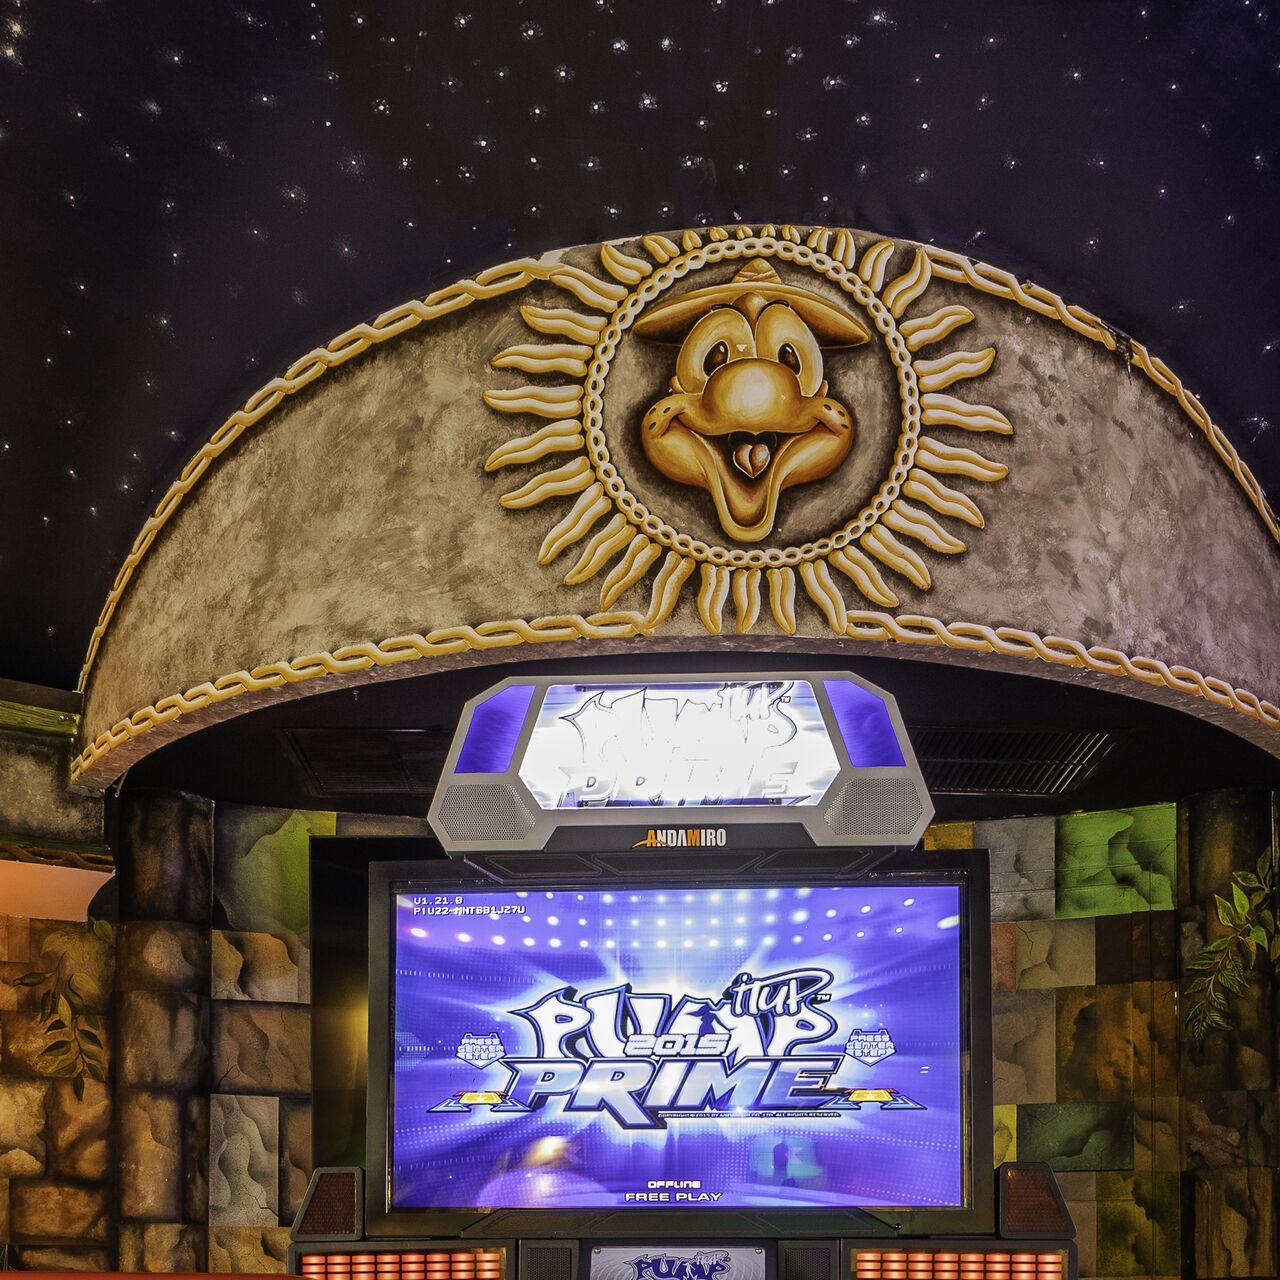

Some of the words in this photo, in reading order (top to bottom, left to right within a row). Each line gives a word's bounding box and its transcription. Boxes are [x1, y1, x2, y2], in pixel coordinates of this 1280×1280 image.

[644, 829, 726, 847] ANDAMIRO
[508, 983, 838, 1061] PUMP
[458, 1045, 504, 1053] CENTER
[625, 1034, 730, 1056] 2015
[508, 1057, 842, 1127] PRIME
[647, 1180, 701, 1189] OFFLINE
[625, 1193, 670, 1201] FREE
[676, 1193, 723, 1201] PLAY
